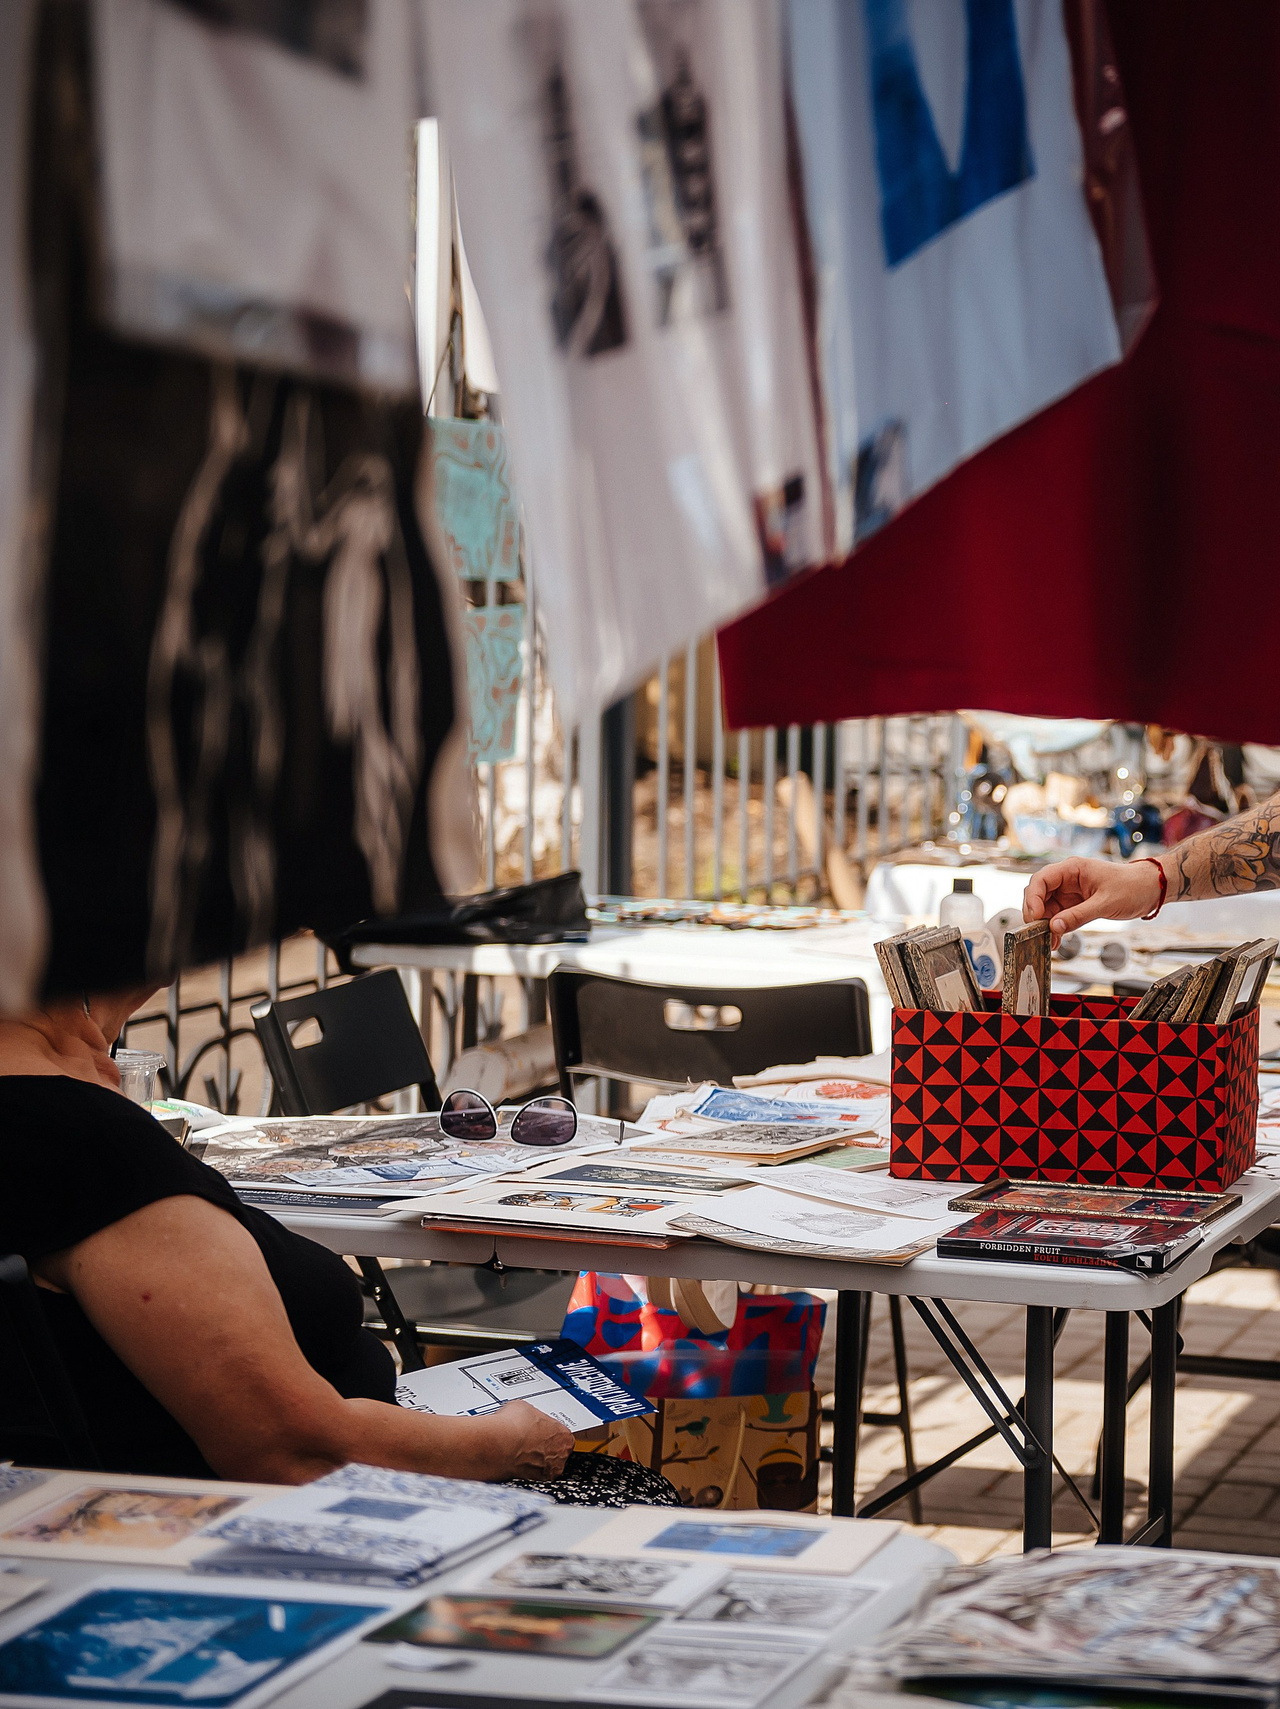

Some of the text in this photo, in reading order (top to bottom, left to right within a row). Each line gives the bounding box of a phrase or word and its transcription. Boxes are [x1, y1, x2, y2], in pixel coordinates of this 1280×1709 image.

[980, 1242, 1061, 1255] FORBIDDEN FRUIT
[1034, 1254, 1119, 1267] ЗАПРЕТНЫЙ ПЛОД
